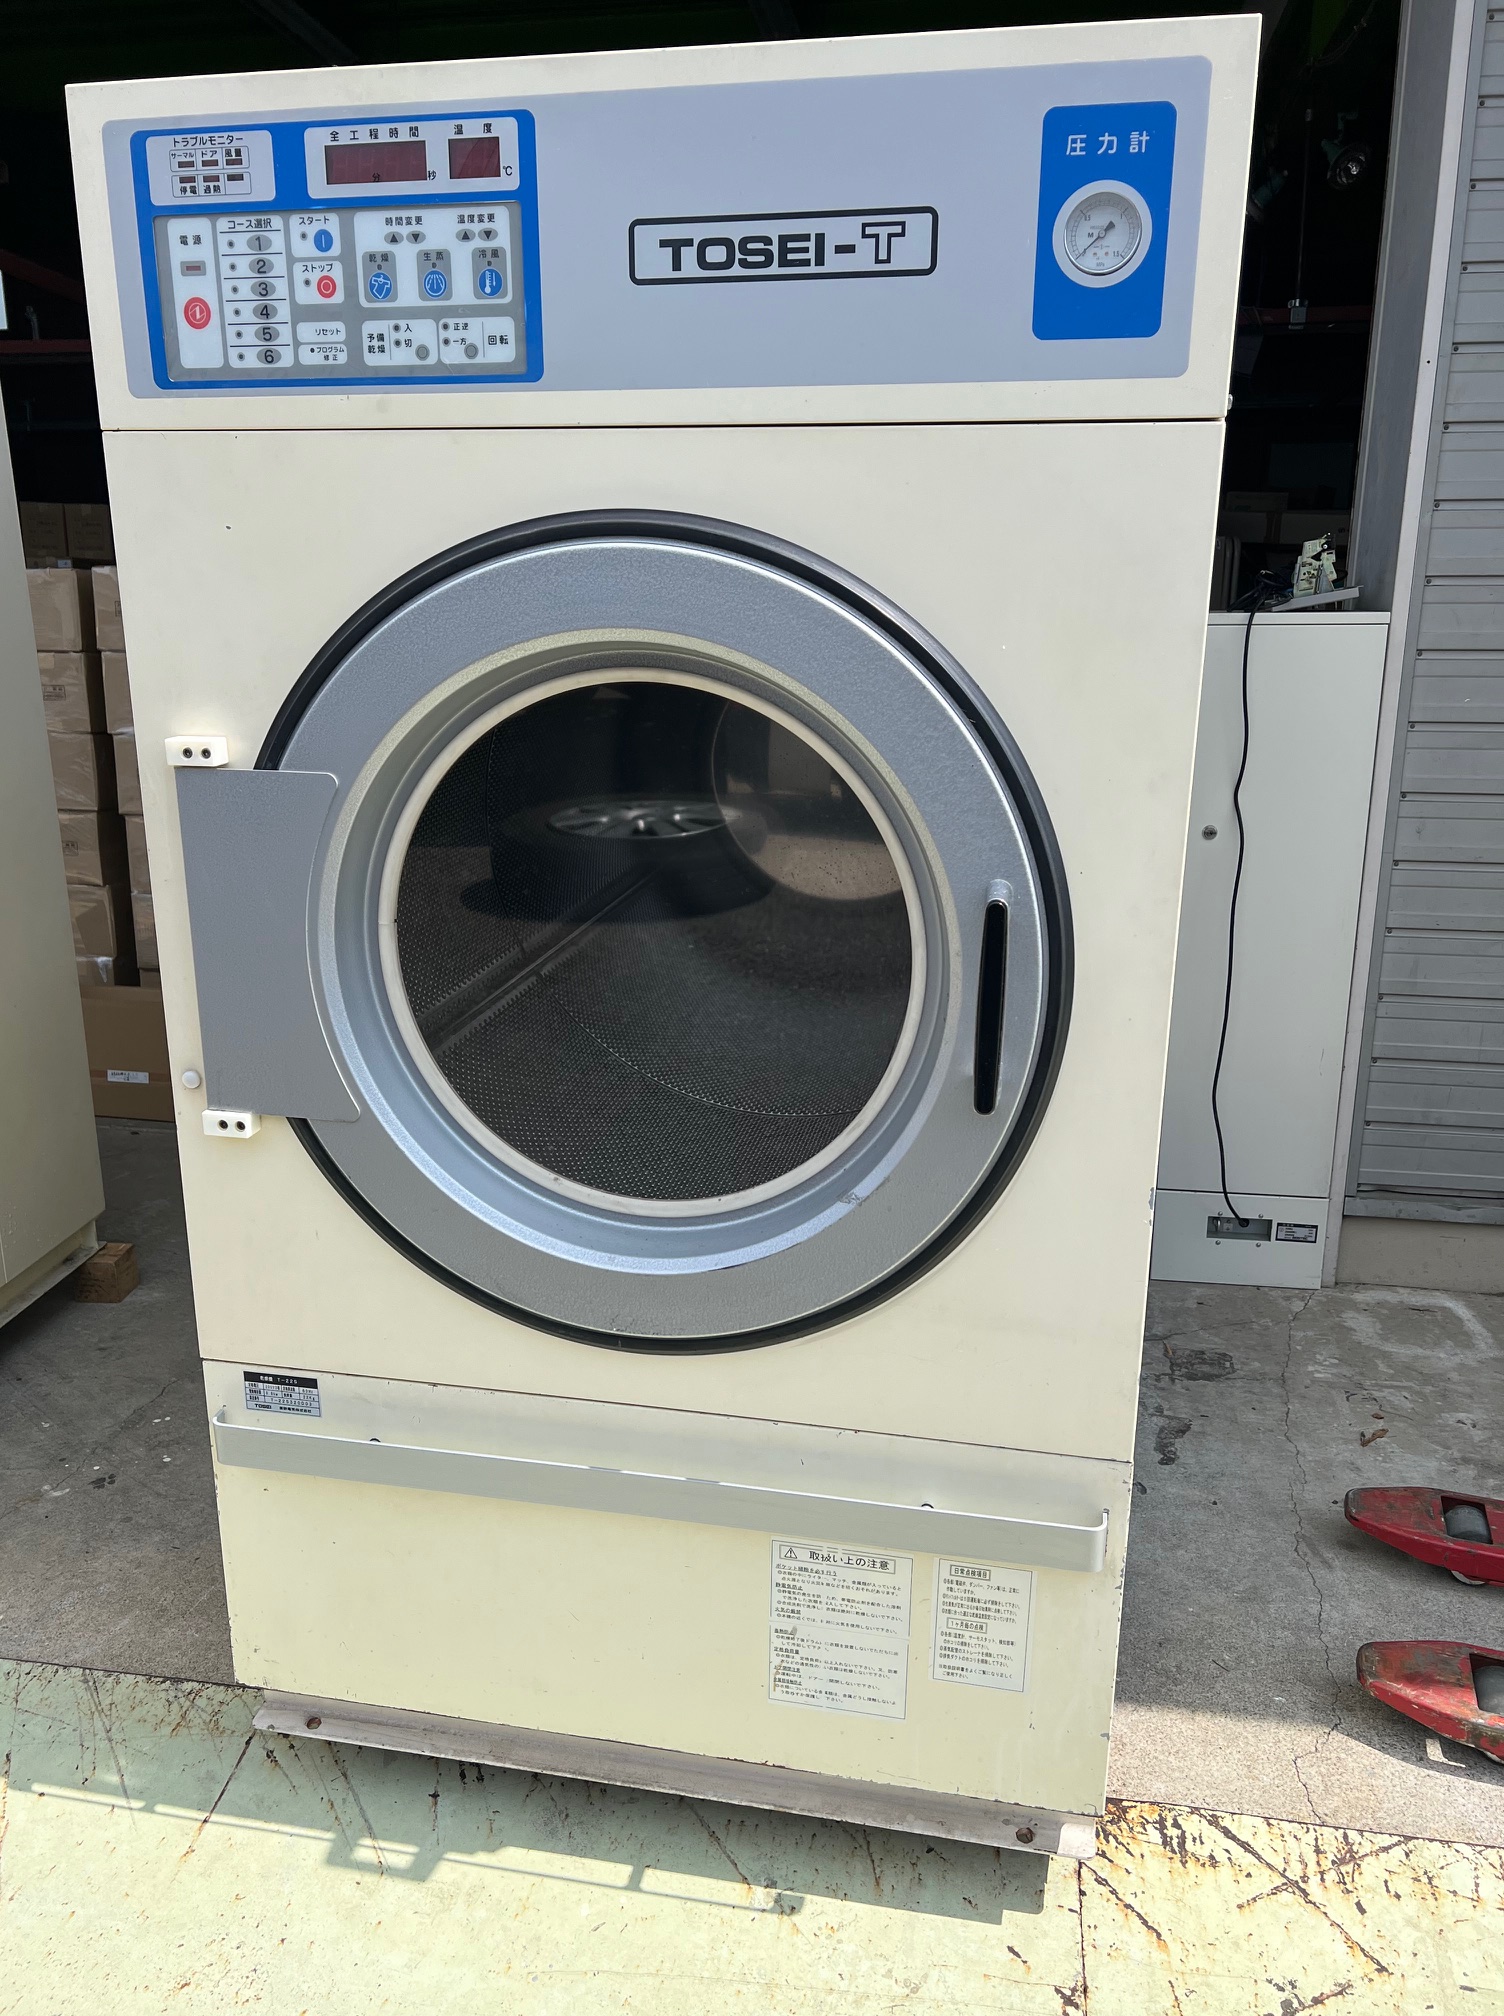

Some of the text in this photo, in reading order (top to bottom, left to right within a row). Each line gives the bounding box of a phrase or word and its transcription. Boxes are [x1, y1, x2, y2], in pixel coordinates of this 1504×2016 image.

[330, 126, 419, 142] 全工程時間
[454, 123, 493, 135] 温度
[173, 134, 243, 147] トラブルモニター
[1066, 130, 1150, 155] 圧力計
[201, 150, 217, 158] ドア
[225, 148, 242, 158] 風量
[372, 173, 381, 182] 分
[428, 170, 436, 181] 秒
[180, 186, 197, 195] 停電
[228, 218, 272, 229] コース選択
[299, 216, 330, 225] スタート
[385, 216, 423, 226] 時間変更
[457, 213, 495, 224] 温度変更
[180, 235, 202, 246] 電源
[255, 236, 262, 251] 1
[478, 249, 500, 259] 冷風
[256, 259, 267, 274] 2
[302, 263, 333, 273] ストップ
[258, 282, 269, 297] 3
[259, 304, 270, 319] 4
[315, 328, 341, 336] リセット
[404, 324, 412, 332] 入
[262, 327, 272, 341] 5
[367, 333, 385, 343] 予備
[404, 338, 412, 347] 切
[488, 335, 509, 345] 回転
[264, 350, 274, 364] 6
